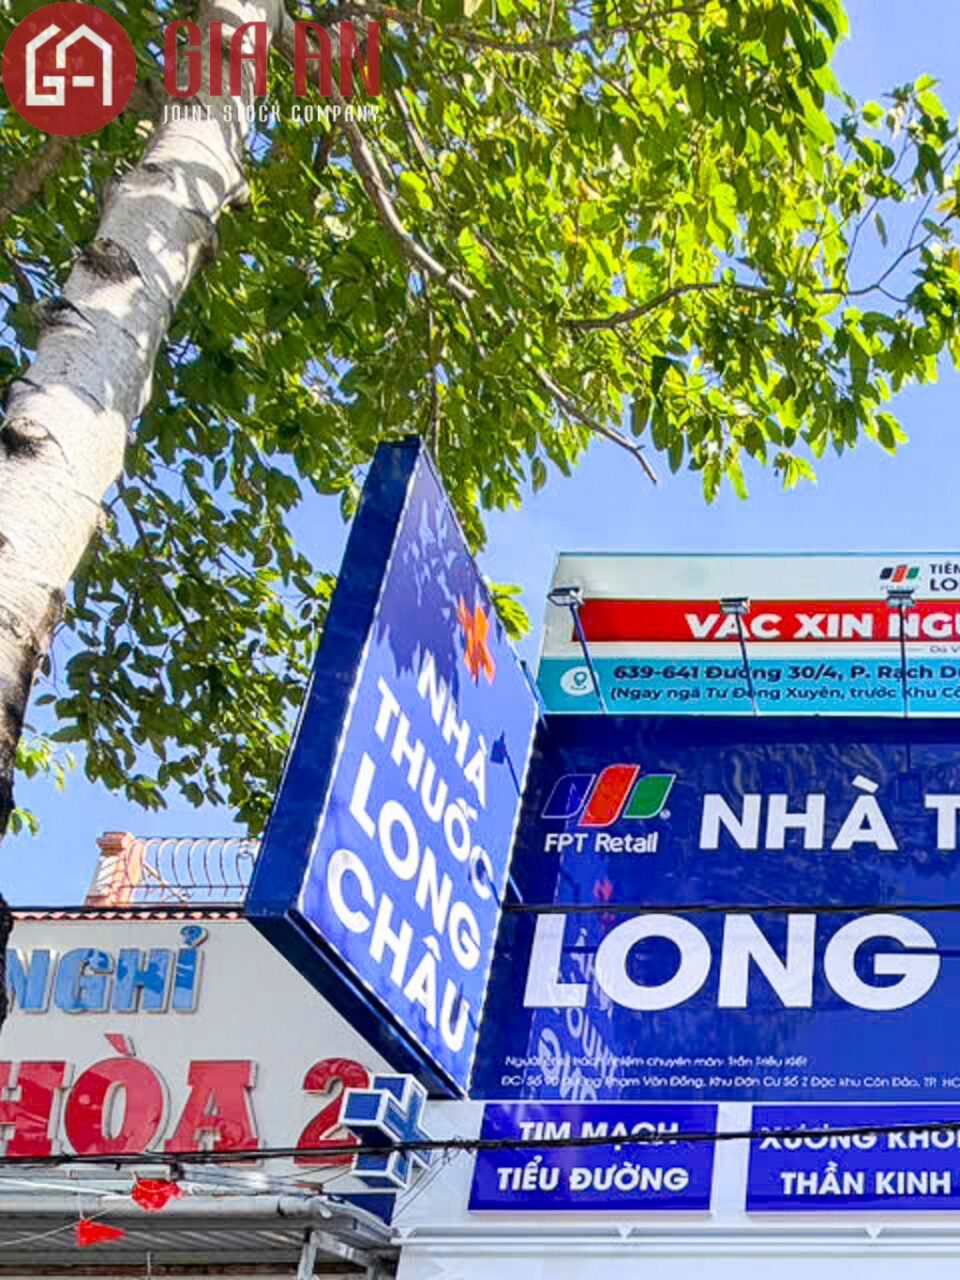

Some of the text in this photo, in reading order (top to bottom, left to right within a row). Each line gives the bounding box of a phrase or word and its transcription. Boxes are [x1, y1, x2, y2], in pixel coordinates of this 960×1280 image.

[793, 613, 873, 639] XIN
[611, 687, 662, 701] (Ngay
[613, 665, 698, 680] 639-641
[788, 663, 843, 681] 30/4,
[851, 666, 870, 679] P.
[418, 650, 488, 809] NHÀ
[373, 675, 495, 900] THUỐC
[699, 775, 898, 851] NHÀ
[349, 751, 482, 973] LONG
[544, 831, 659, 853] FPT Retail
[327, 847, 471, 1053] CHÂU
[523, 913, 941, 1011] LONG
[294, 1057, 371, 1165] 2
[519, 1122, 571, 1141] TIM
[497, 1155, 689, 1191] TIỂU ĐƯỜNG
[780, 1161, 951, 1195] THẦN KINH
